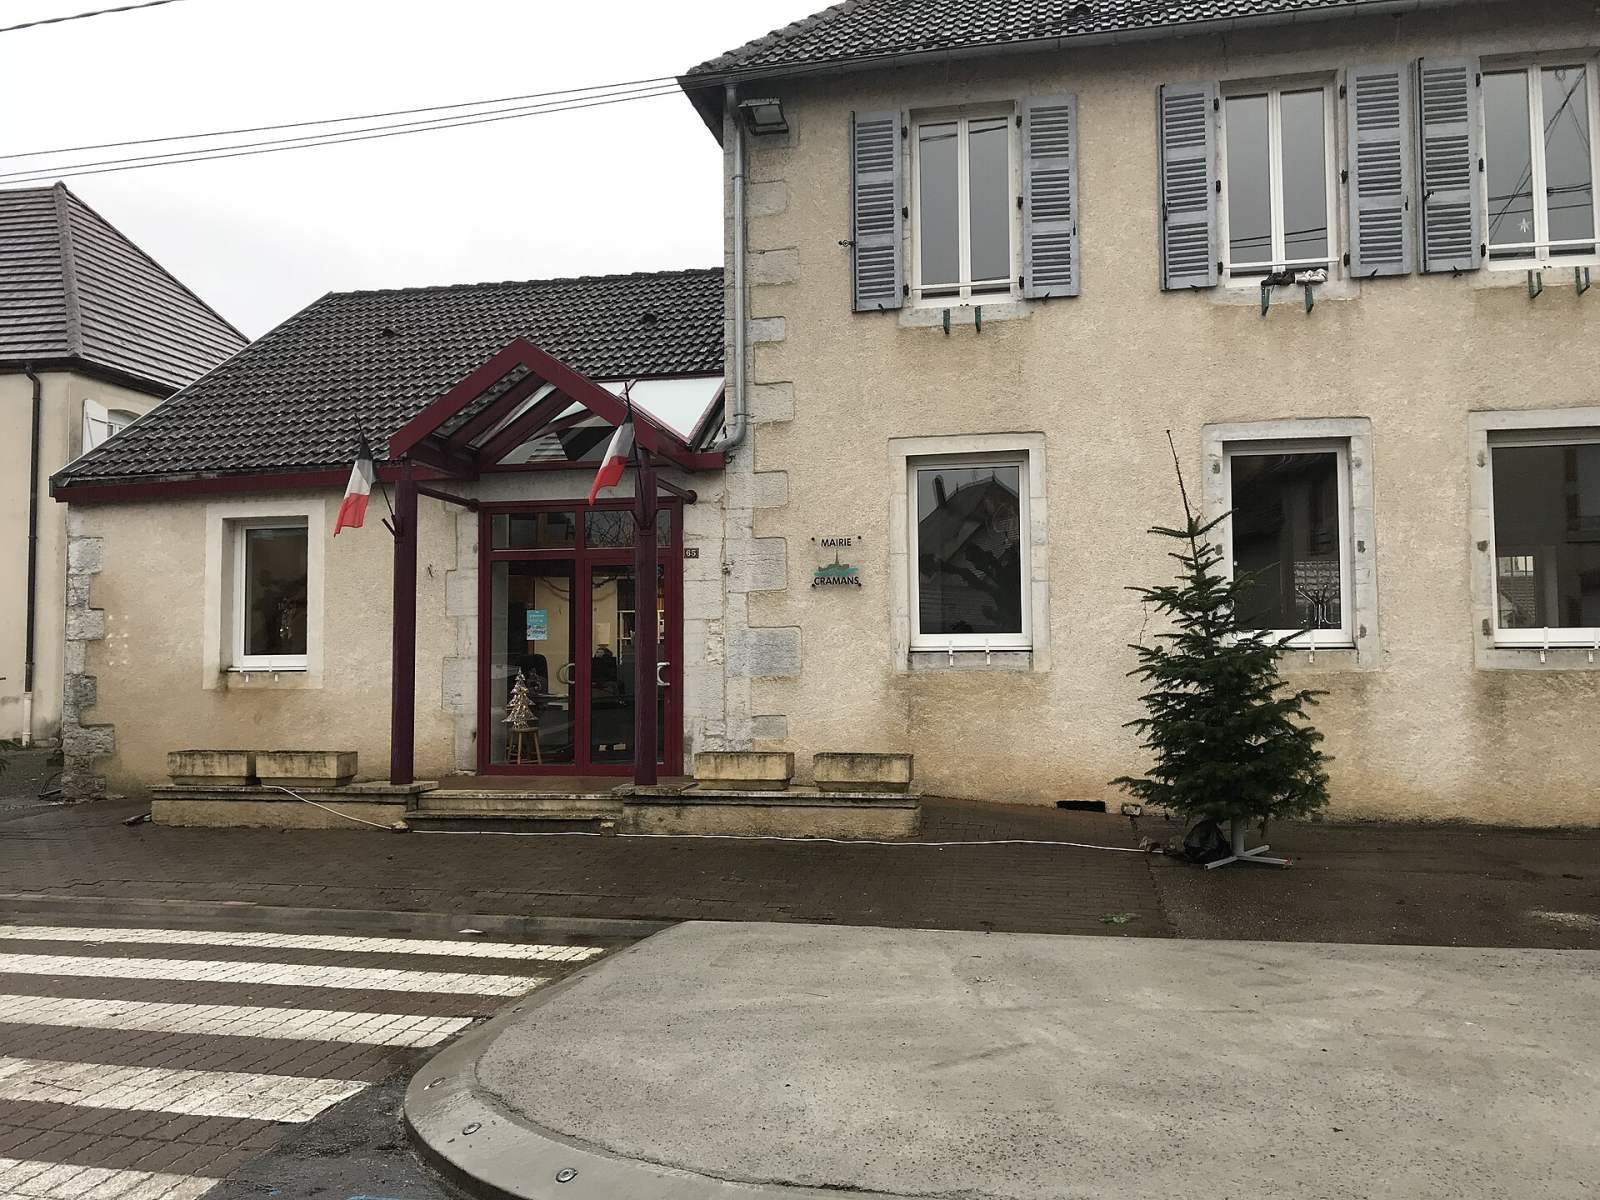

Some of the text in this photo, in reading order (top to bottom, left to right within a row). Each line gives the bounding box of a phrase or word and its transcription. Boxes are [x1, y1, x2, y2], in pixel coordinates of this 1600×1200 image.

[821, 538, 851, 547] MAIRIE
[685, 549, 696, 557] 65
[814, 576, 859, 585] CRAMANS
